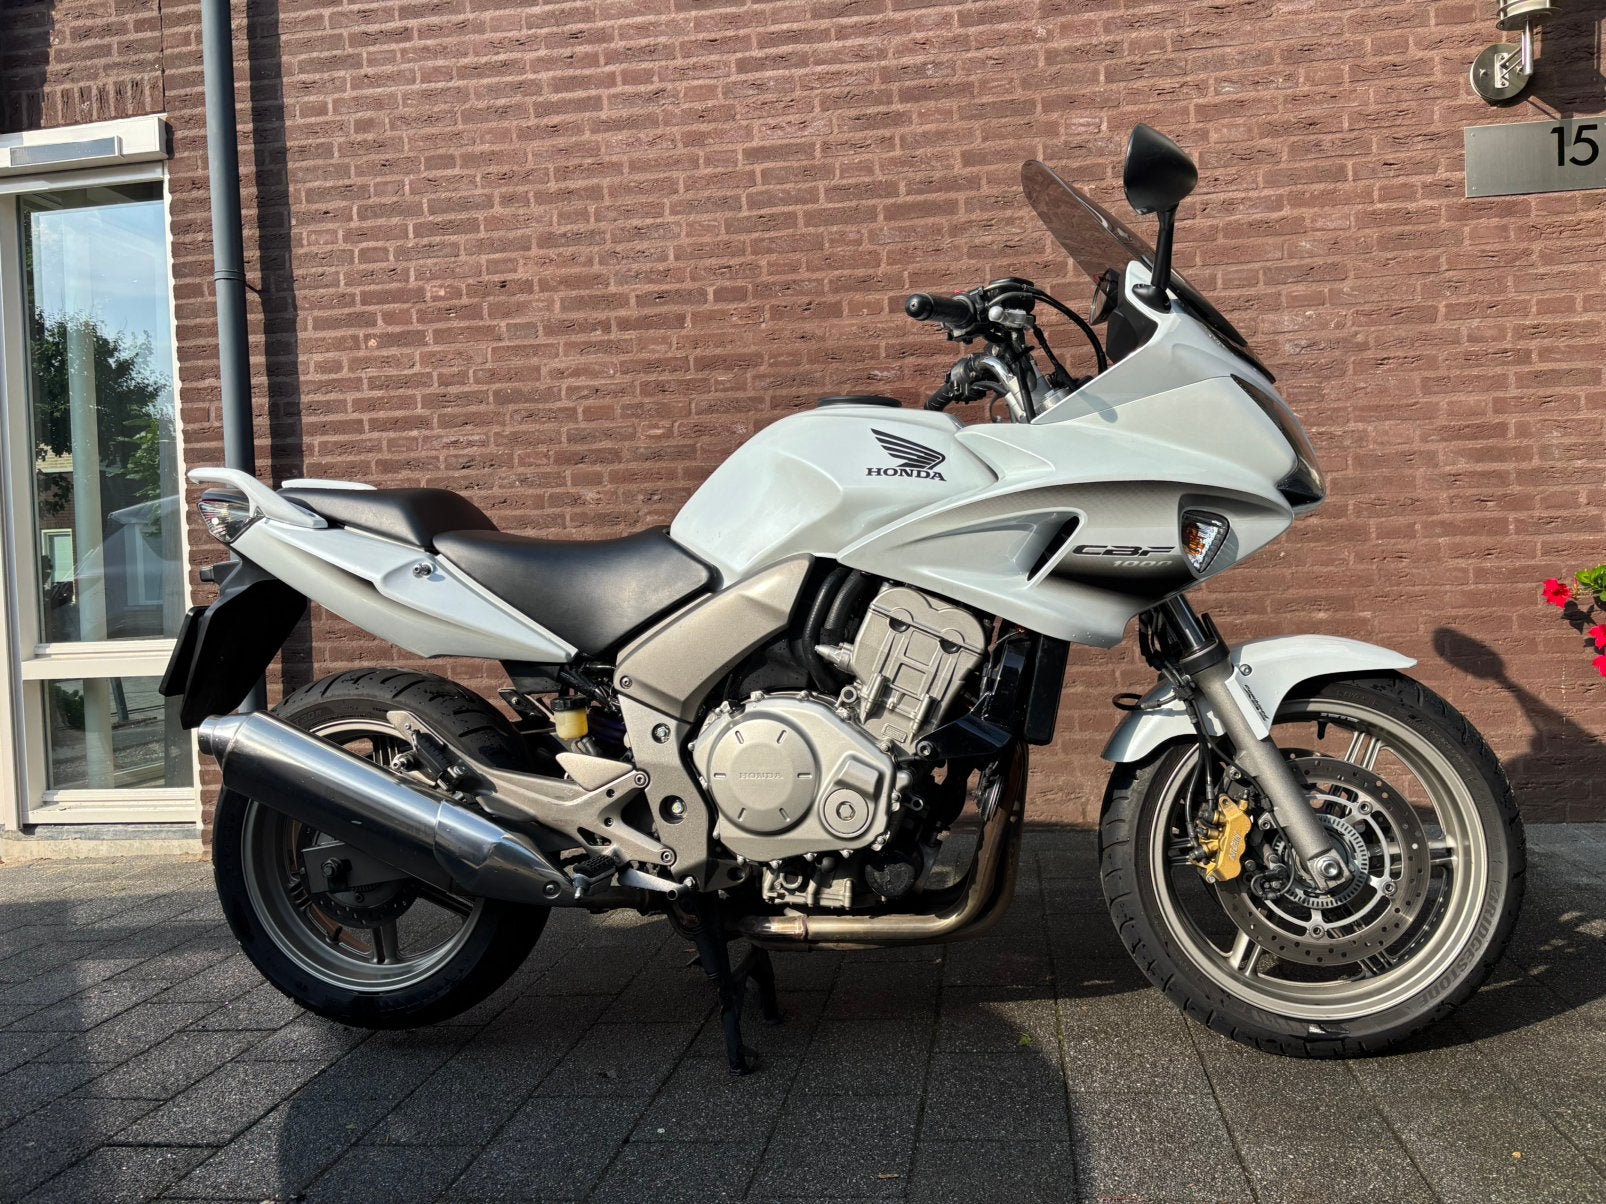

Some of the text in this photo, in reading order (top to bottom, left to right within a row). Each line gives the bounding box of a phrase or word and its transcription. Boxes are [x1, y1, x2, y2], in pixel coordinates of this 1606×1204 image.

[1550, 124, 1600, 167] 15
[865, 467, 947, 481] HONDA
[1072, 544, 1176, 557] CBF
[1113, 560, 1173, 568] 1000
[738, 772, 784, 780] HONDA
[1416, 883, 1501, 1008] BRIDGESTONE
